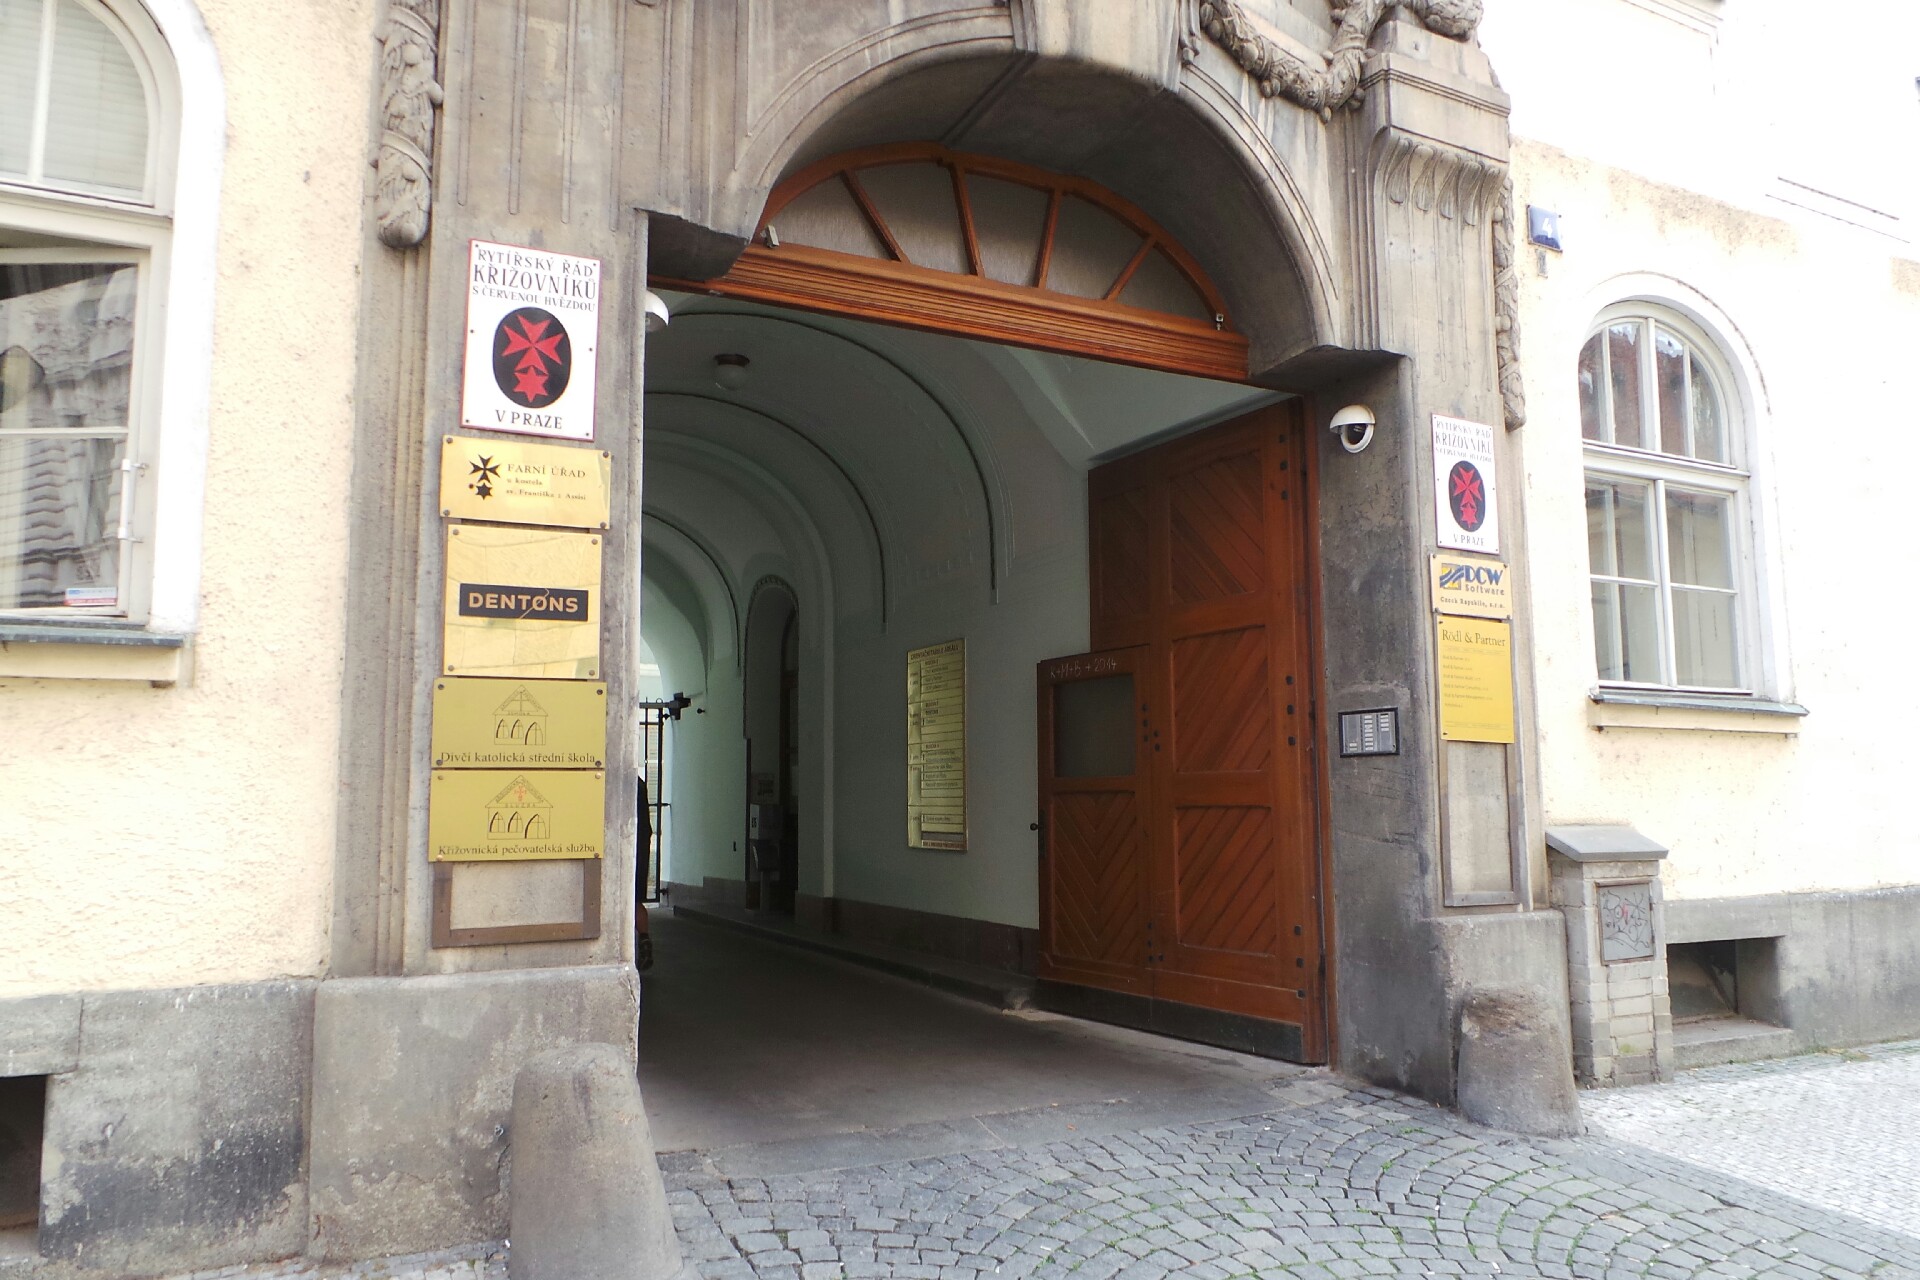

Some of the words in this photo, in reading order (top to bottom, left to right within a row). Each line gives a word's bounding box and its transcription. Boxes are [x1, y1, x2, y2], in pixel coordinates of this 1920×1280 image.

[478, 249, 554, 271] RYTÍŘSKÝ
[562, 256, 593, 277] ŘÁD
[473, 264, 597, 299] KŘIŽOVNÍKŮ
[472, 285, 479, 295] S
[481, 286, 540, 304] ČERVENOU
[544, 295, 596, 312] HVĚZDOU
[495, 409, 506, 423] V
[511, 411, 563, 429] PRAZE
[507, 462, 546, 475] FARNÍ
[551, 465, 586, 478] ÚŘAD
[515, 477, 543, 486] kostela
[1463, 564, 1504, 586] DCW
[1465, 584, 1505, 596] Software
[468, 592, 579, 613] DENTONS
[1440, 596, 1458, 605] Czech
[1442, 629, 1462, 643] Rödl
[1464, 632, 1474, 643] &
[1475, 632, 1506, 647] Partner
[1094, 657, 1117, 672] 2014
[474, 751, 526, 763] katolická
[528, 751, 564, 763] střední
[568, 751, 596, 763] škola
[438, 844, 498, 856] Křižovnická
[501, 844, 563, 856] pečovatelská
[566, 844, 596, 854] služba
